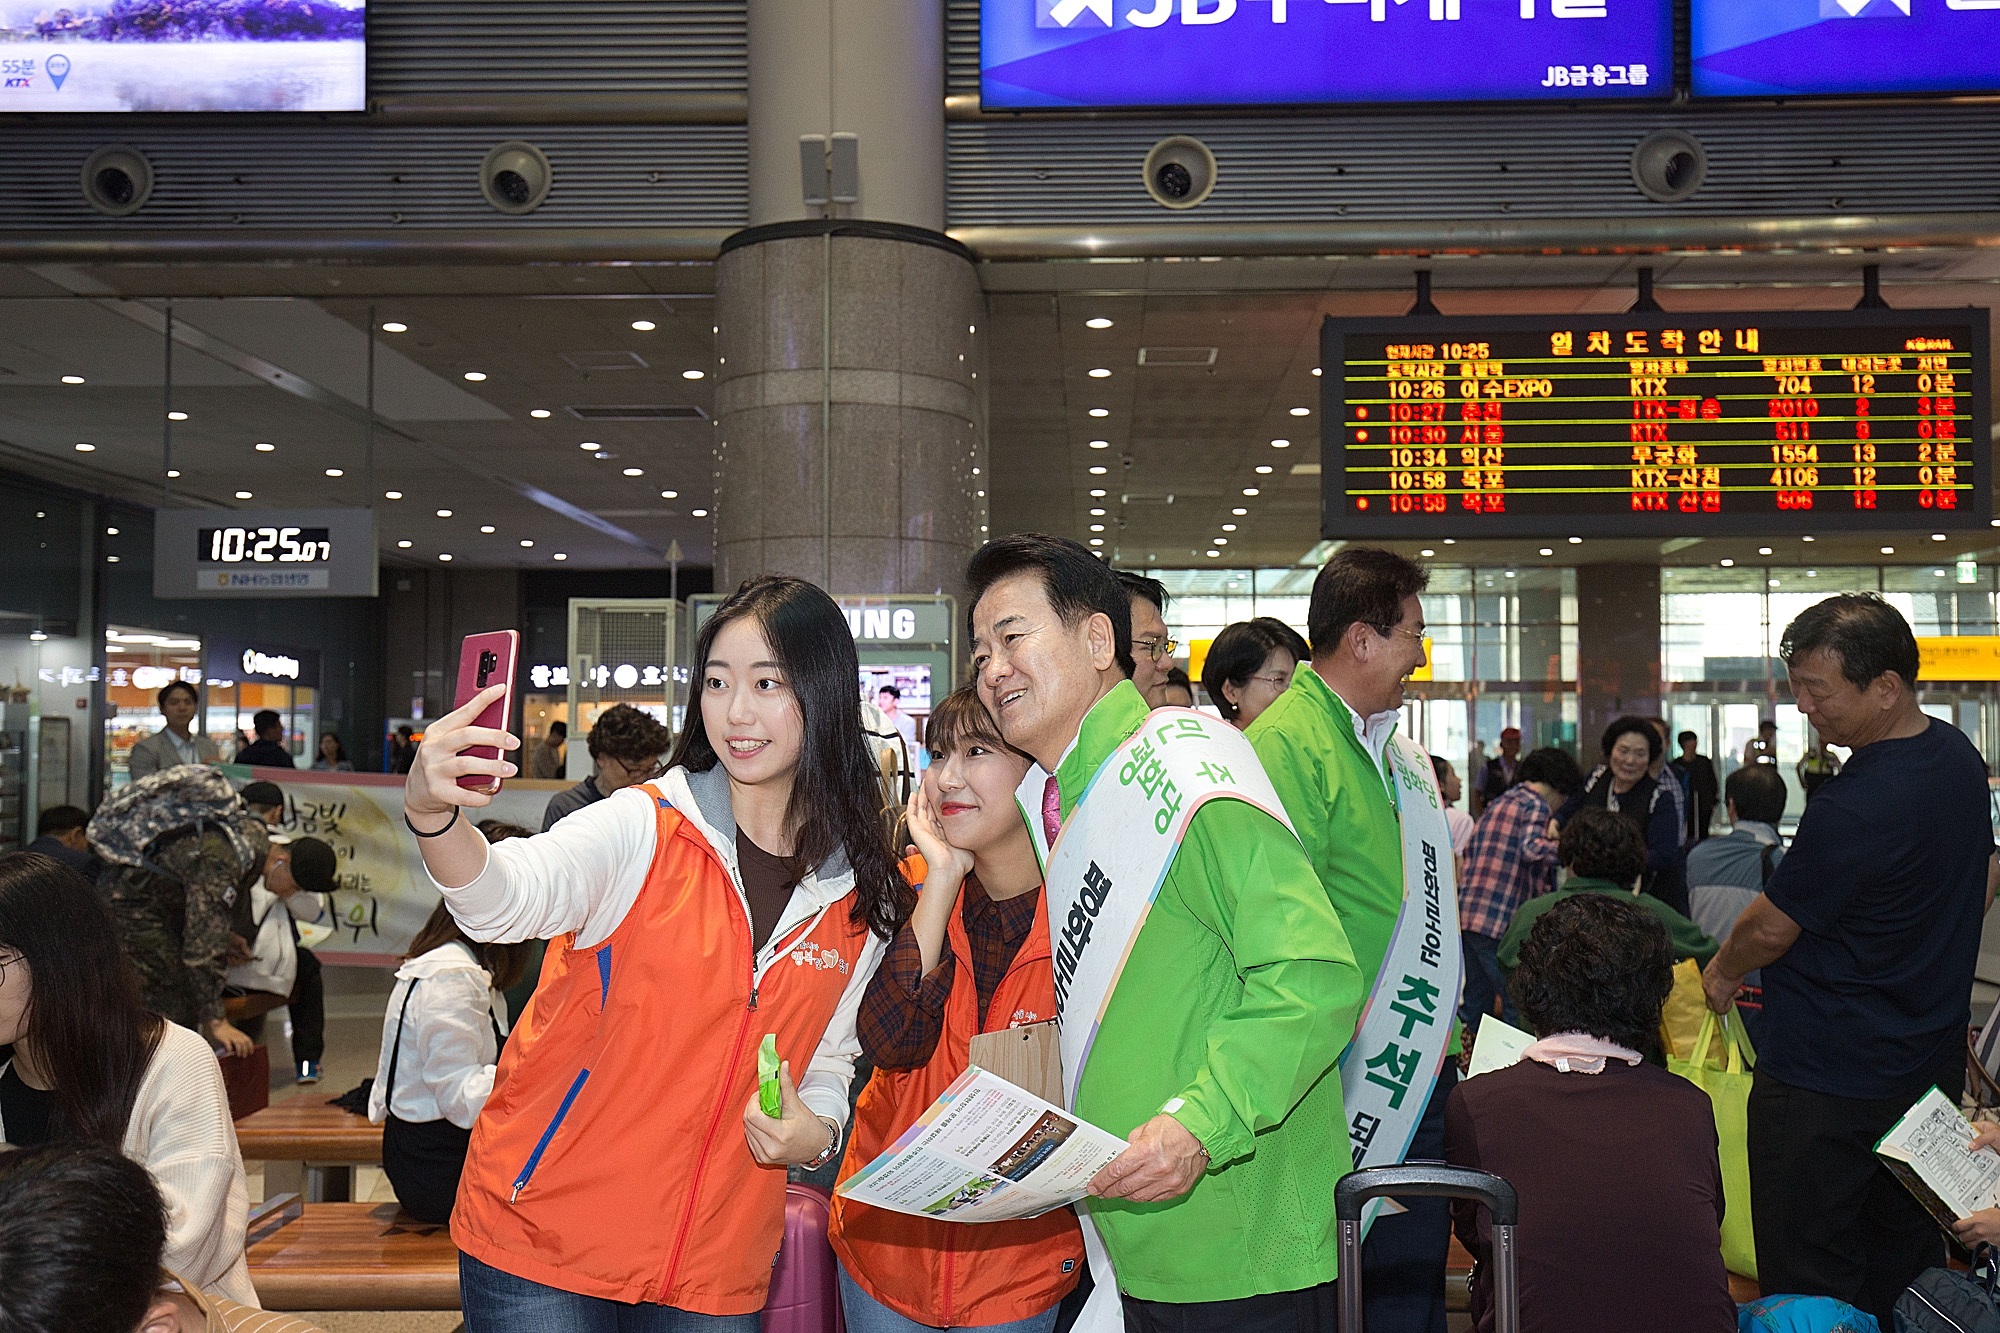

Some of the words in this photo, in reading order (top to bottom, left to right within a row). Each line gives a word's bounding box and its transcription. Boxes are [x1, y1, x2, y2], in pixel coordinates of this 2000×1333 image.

[4, 76, 36, 87] KTX
[1541, 64, 1650, 87] JB금융그룹
[1440, 343, 1490, 359] 10:25
[1389, 380, 1446, 399] 10:26
[1629, 377, 1668, 397] KTX
[1774, 375, 1812, 395] 704
[1851, 373, 1876, 394] 12
[1388, 402, 1446, 422] 10:27
[1768, 399, 1819, 418] 2010
[1855, 397, 1870, 417] 2
[1388, 426, 1447, 445] 10:30
[1460, 424, 1504, 445] 서울
[1629, 422, 1668, 442] KTX
[1775, 421, 1810, 441] 511
[1389, 448, 1448, 467] 10:34
[1460, 446, 1504, 468] 익산
[1631, 444, 1699, 466] 무궁화
[1770, 444, 1819, 464] 1554
[1853, 443, 1876, 464] 13
[1388, 470, 1447, 490] 10:58
[1460, 469, 1505, 491] 목포
[1631, 467, 1720, 489] KTX-산천
[1769, 466, 1819, 487] 4106
[1853, 465, 1876, 486] 12
[1388, 493, 1447, 513] 10:58
[1853, 489, 1876, 509] 12
[1119, 737, 1183, 835] 평화당
[1420, 839, 1442, 968] 평화로운
[1365, 974, 1440, 1110] 추석
[940, 1111, 957, 1129] 문제를
[921, 1127, 942, 1148] 해결하는
[893, 1145, 923, 1171] 민주평화당이
